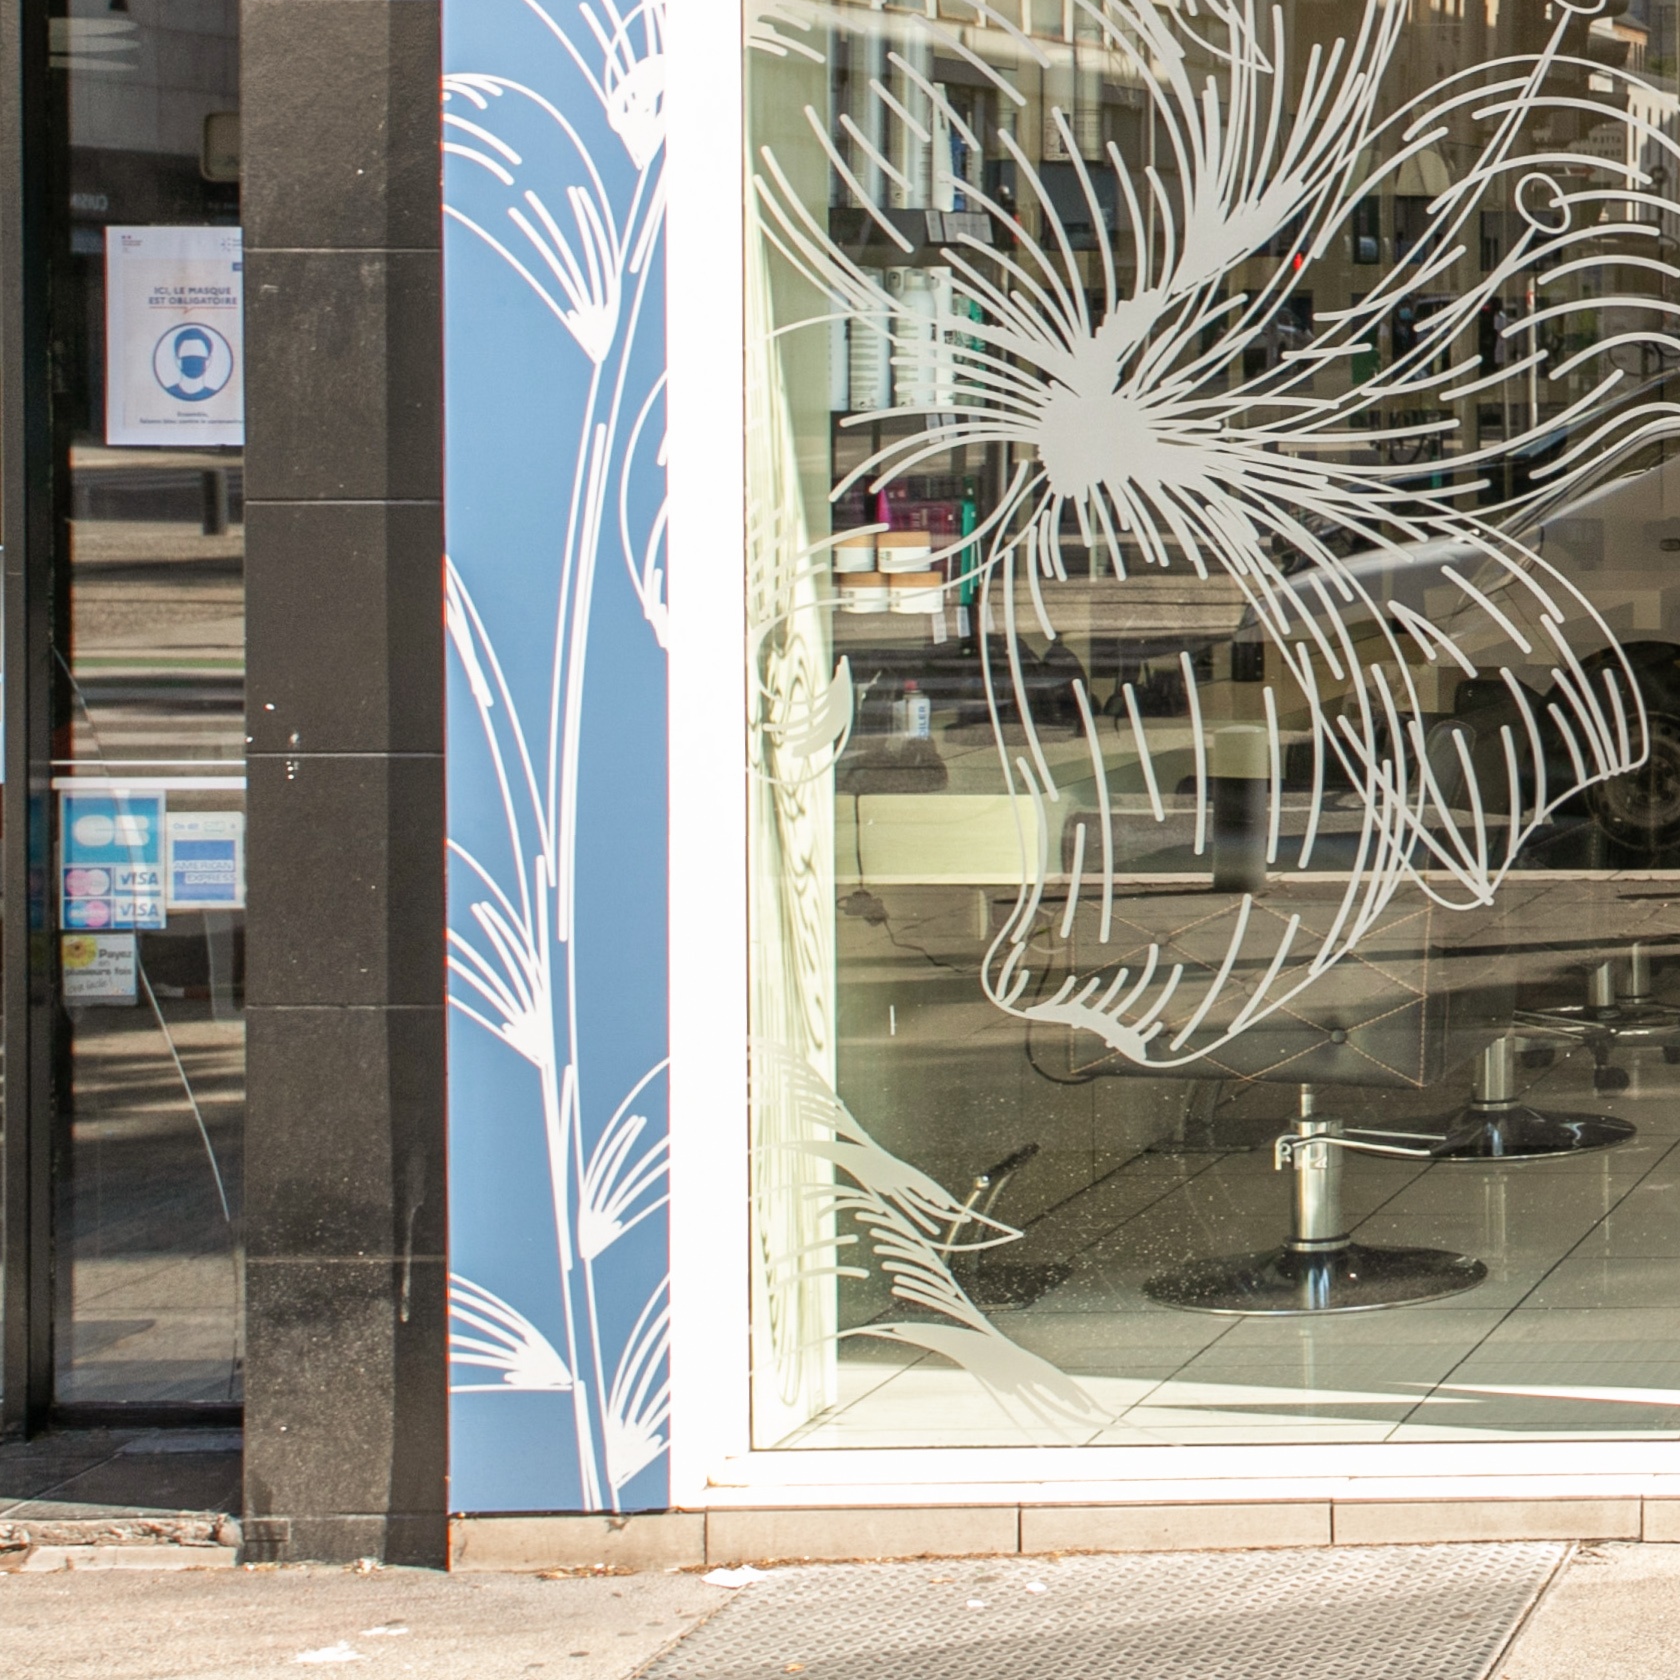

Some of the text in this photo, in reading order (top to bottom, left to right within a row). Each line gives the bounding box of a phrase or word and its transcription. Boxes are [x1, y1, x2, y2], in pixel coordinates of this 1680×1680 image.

[154, 287, 231, 296] ICI, LE MASQUE
[148, 297, 238, 306] EST OBLIGATOIRE
[174, 861, 232, 870] AMERICAN
[120, 872, 158, 885] VISA
[187, 874, 236, 882] EXPRESS
[120, 903, 158, 916] VISA
[99, 949, 132, 960] Payez
